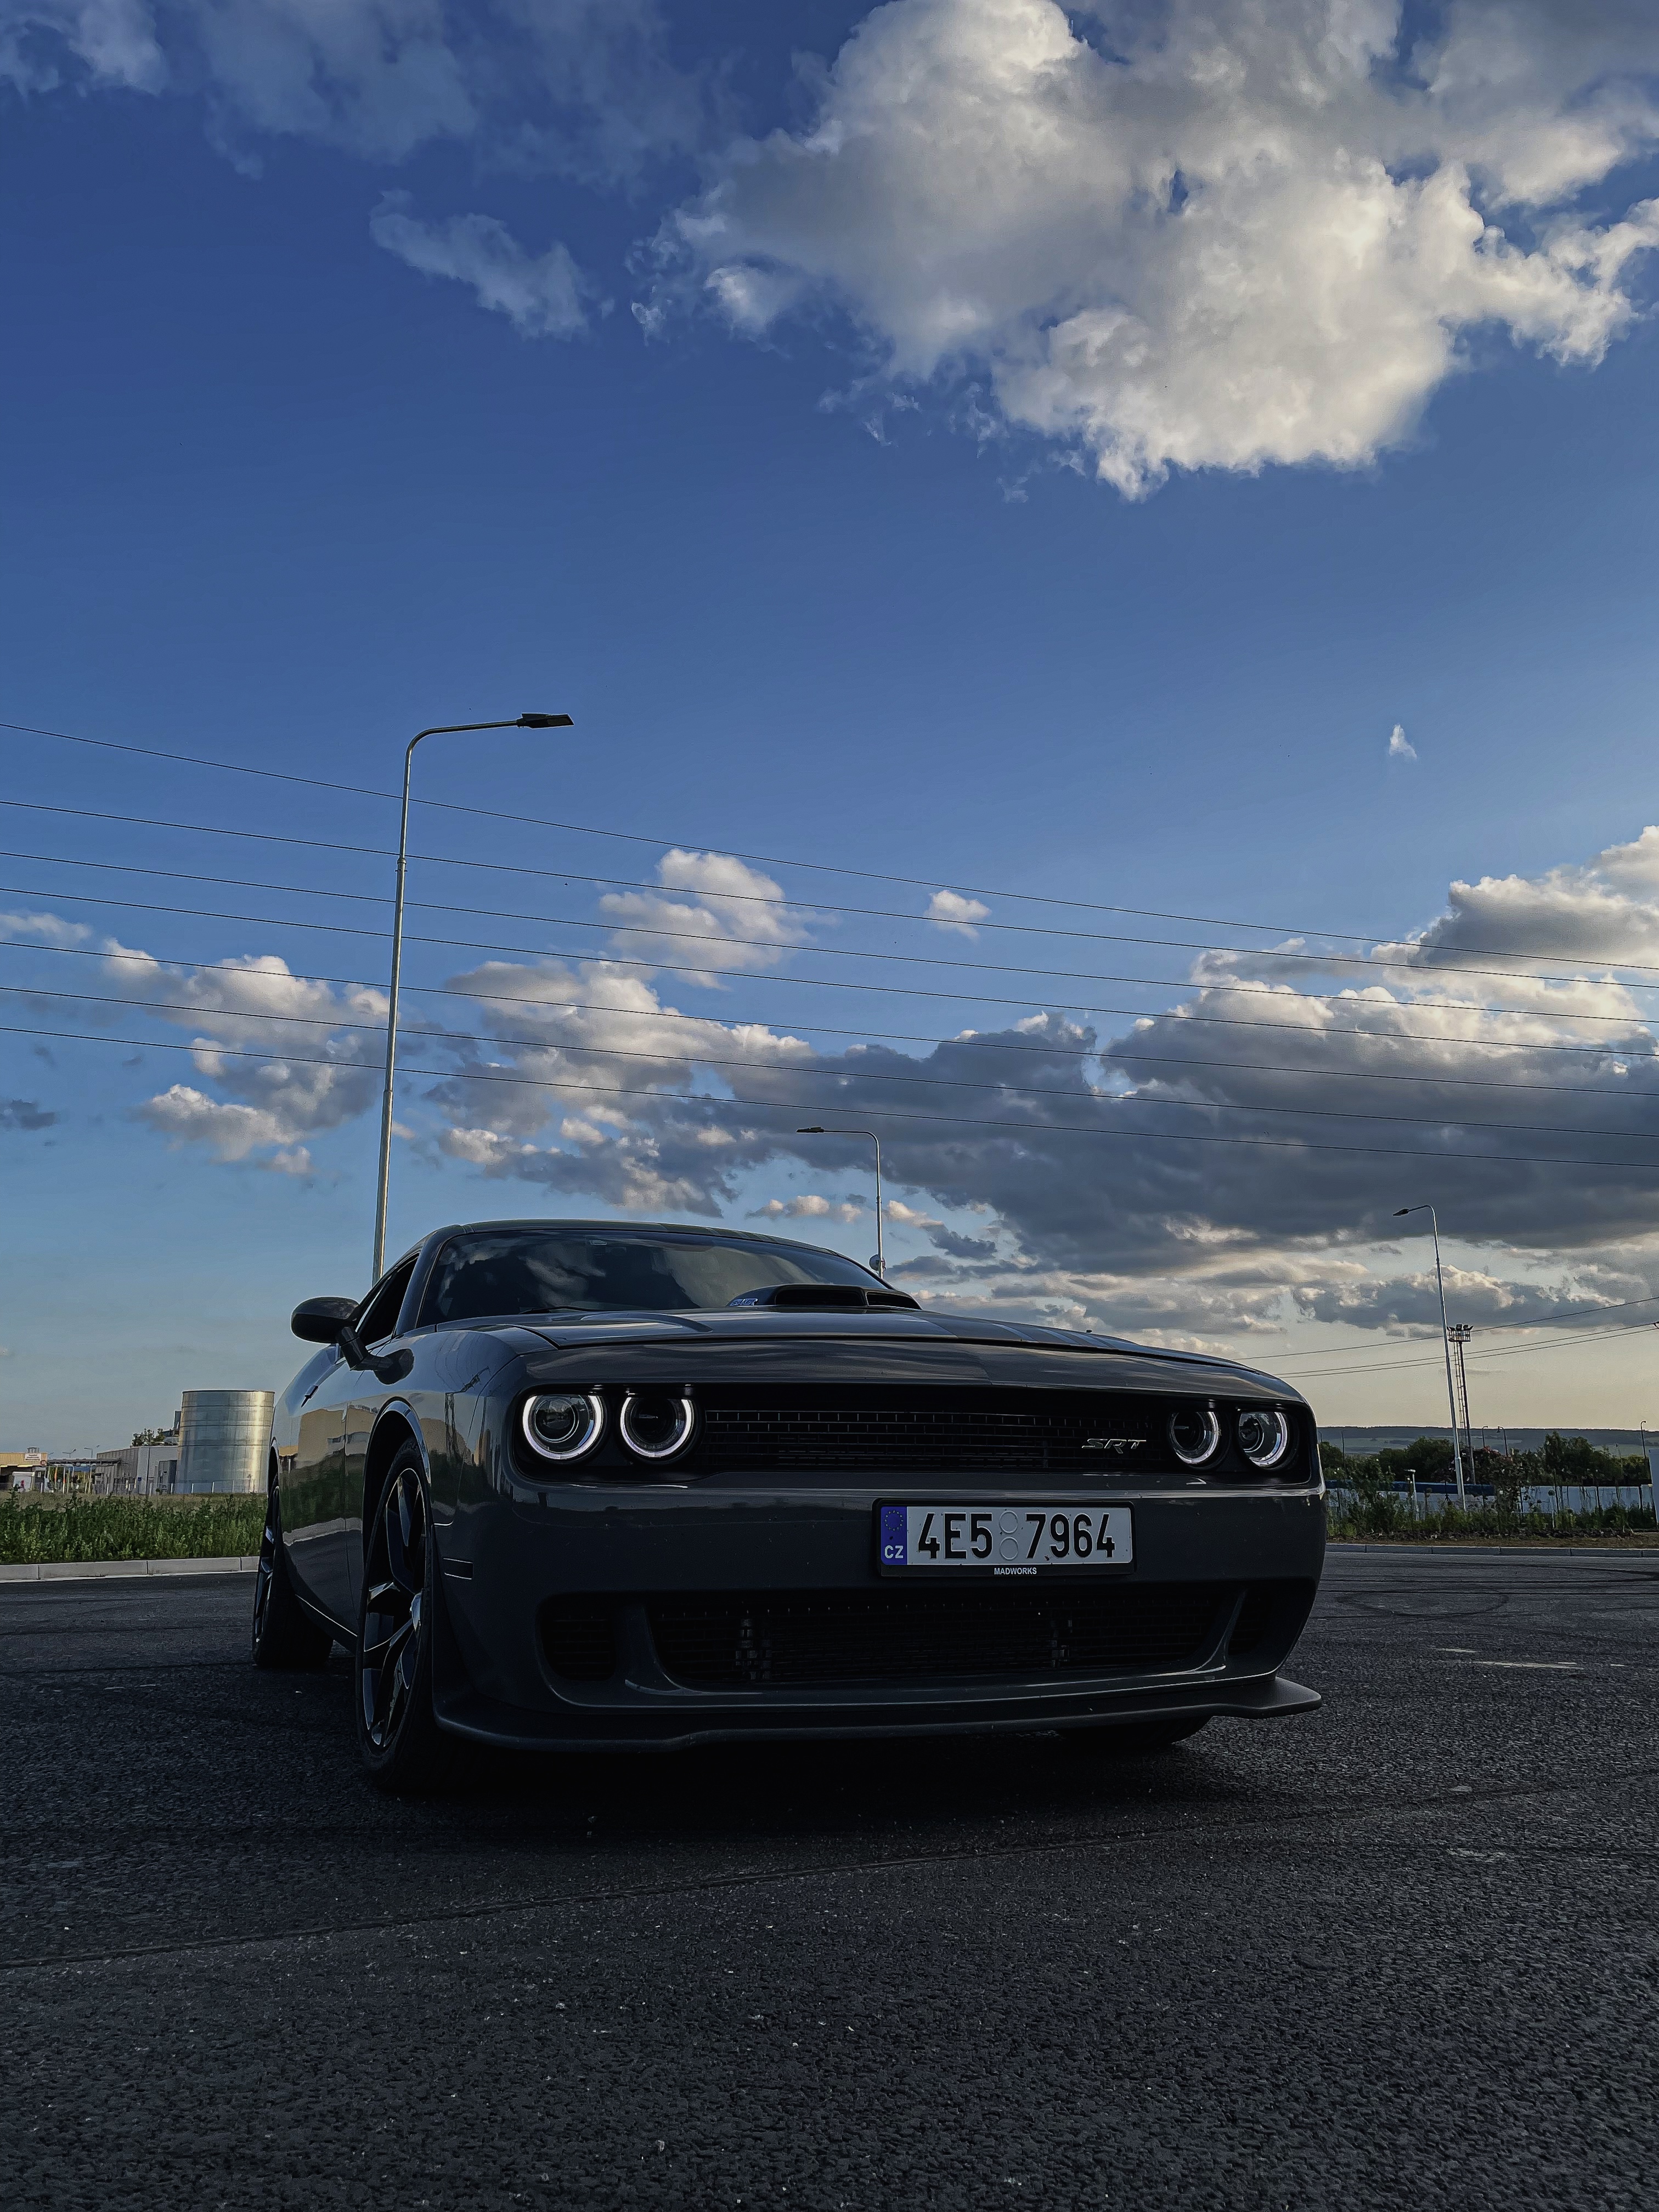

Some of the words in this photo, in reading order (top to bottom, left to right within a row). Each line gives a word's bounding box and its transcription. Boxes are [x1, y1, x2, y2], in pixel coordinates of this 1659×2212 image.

[1081, 1438, 1147, 1454] SRT
[917, 1513, 992, 1559] 4E5
[1025, 1513, 1115, 1559] 7964
[884, 1545, 904, 1559] CZ
